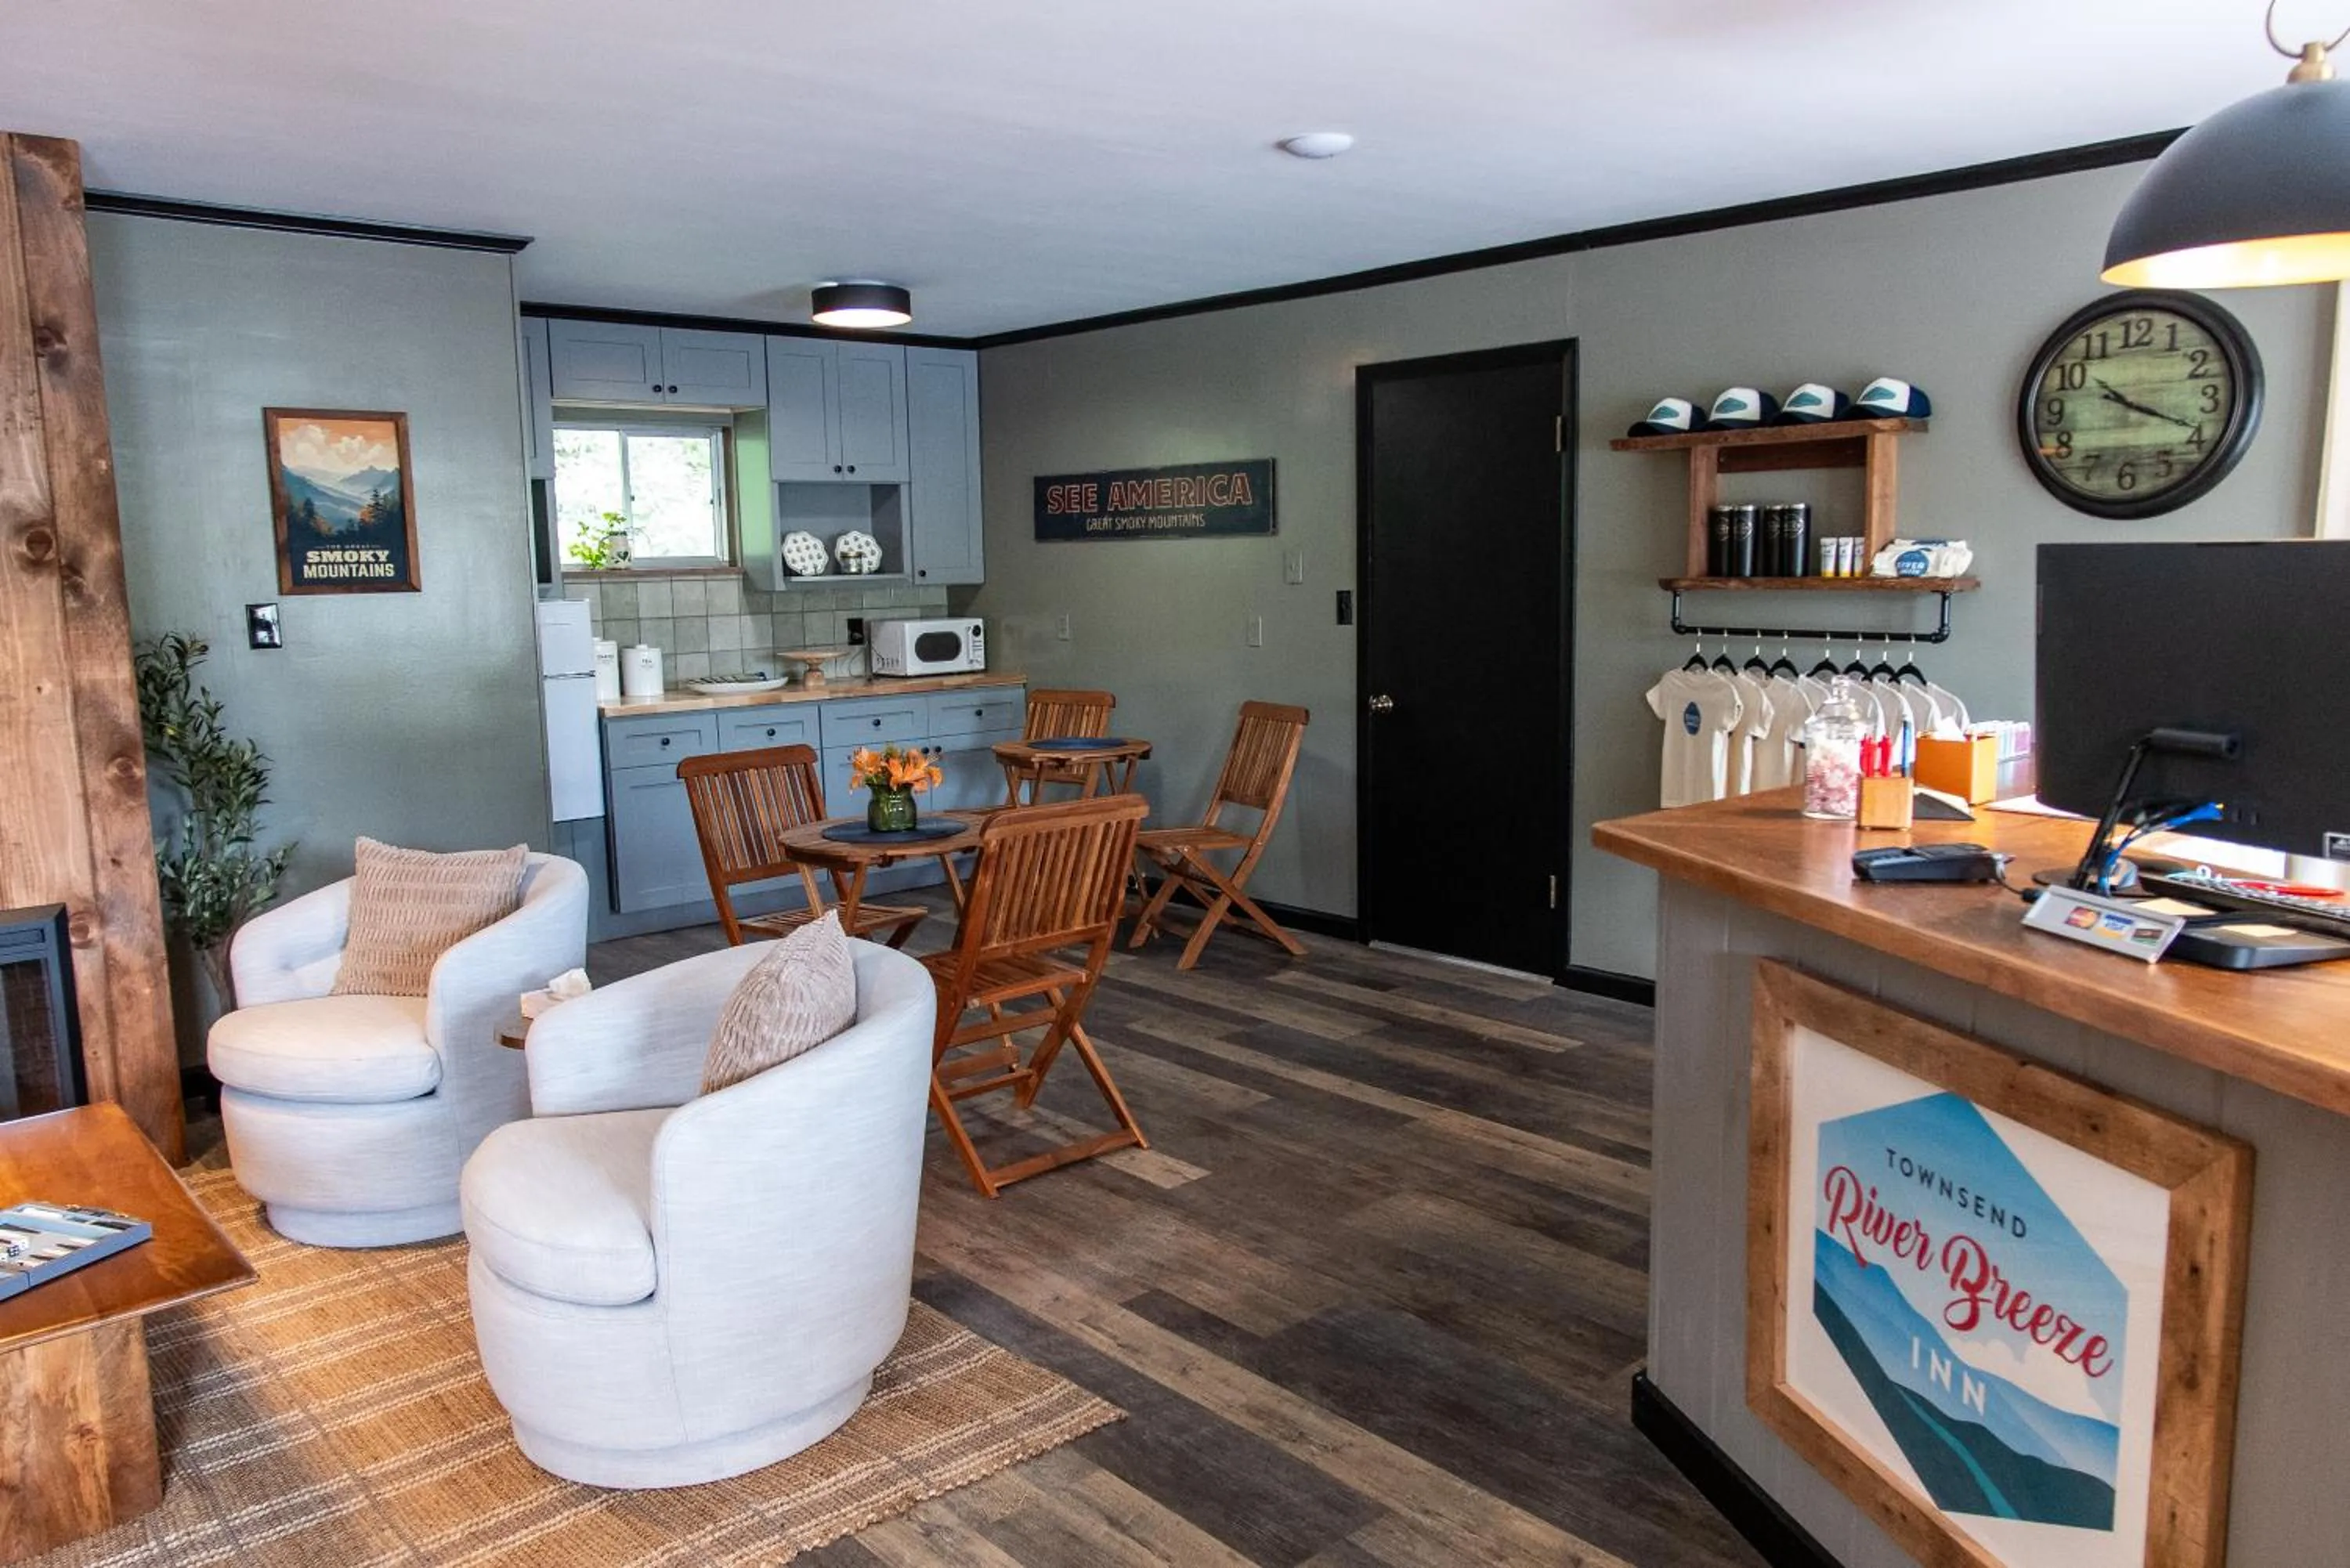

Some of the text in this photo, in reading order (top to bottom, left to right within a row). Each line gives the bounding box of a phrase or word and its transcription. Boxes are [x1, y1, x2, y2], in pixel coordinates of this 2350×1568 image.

[2081, 331, 2110, 361] 11
[2118, 317, 2153, 349] 12
[2164, 322, 2181, 352] 1
[2055, 362, 2087, 392] 10
[2188, 349, 2209, 380] 2
[2047, 398, 2065, 426] 9
[2200, 385, 2219, 414] 3
[2055, 431, 2073, 460] 8
[2186, 421, 2207, 450] 4
[2082, 453, 2102, 481] 7
[2117, 462, 2136, 490] 6
[2155, 449, 2173, 478] 5
[1047, 472, 1253, 514] SEE AMERICA
[1086, 513, 1206, 532] GREAT SMOKY MOUNTAINS
[303, 563, 395, 579] MOUNTAINS
[306, 550, 390, 563] SMOKY
[1885, 1147, 2026, 1238] TOWNSEND
[1824, 1165, 2114, 1378] River Breeze
[1910, 1335, 1987, 1417] INN
